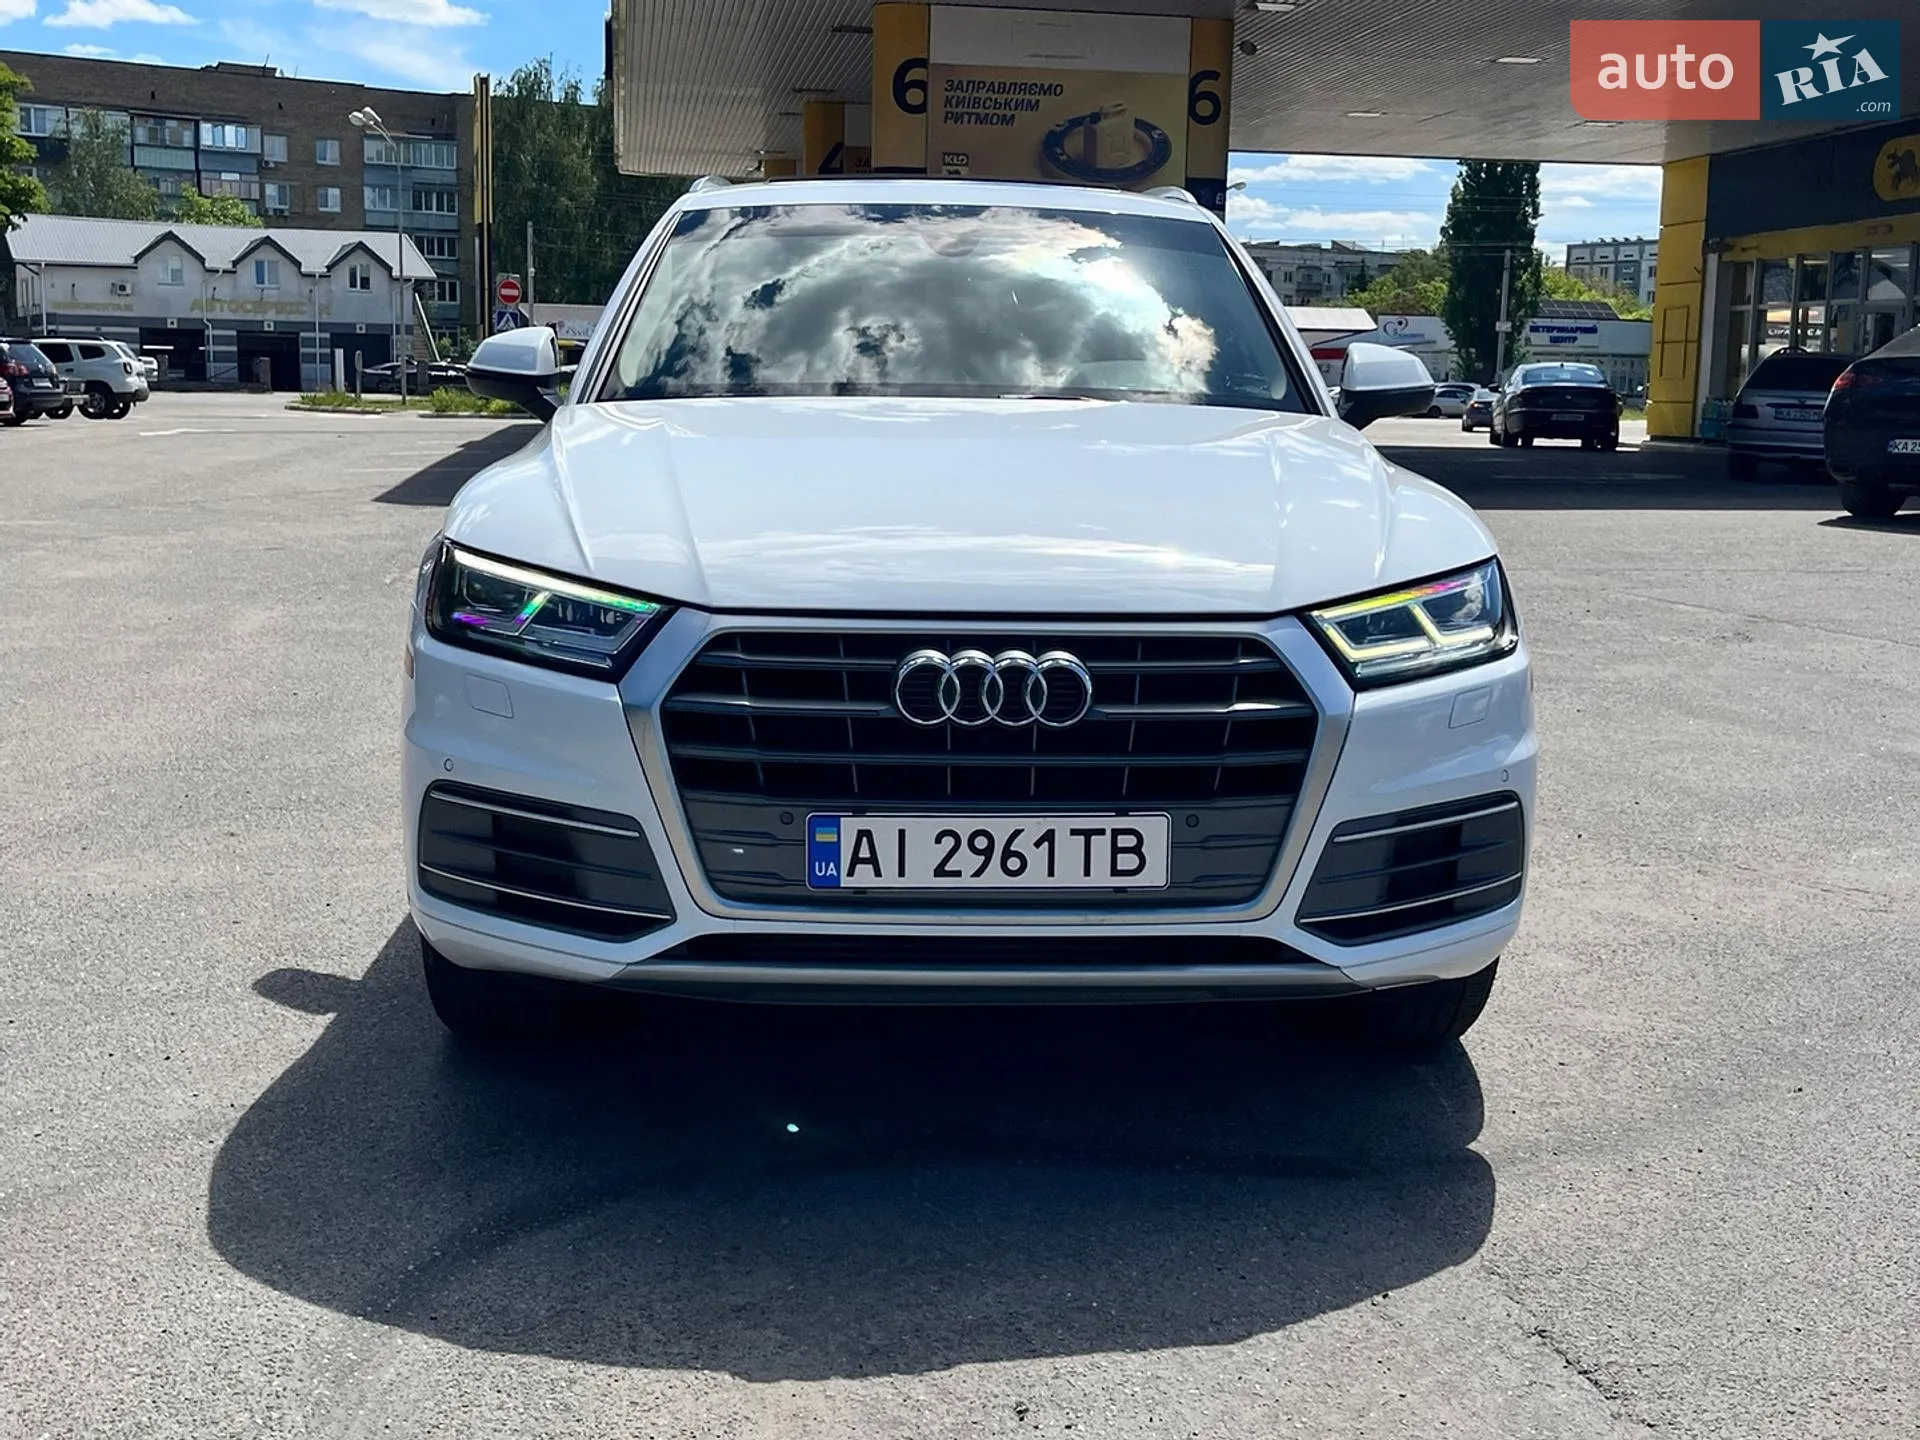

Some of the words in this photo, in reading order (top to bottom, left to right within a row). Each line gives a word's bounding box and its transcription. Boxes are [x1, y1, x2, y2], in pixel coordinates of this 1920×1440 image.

[892, 57, 928, 115] 6
[943, 79, 1064, 97] ЗАПРАВЛЯЄМО
[1188, 69, 1222, 126] 6
[943, 111, 1016, 127] РИТМОМ
[814, 861, 838, 877] UA
[846, 828, 906, 878] AI
